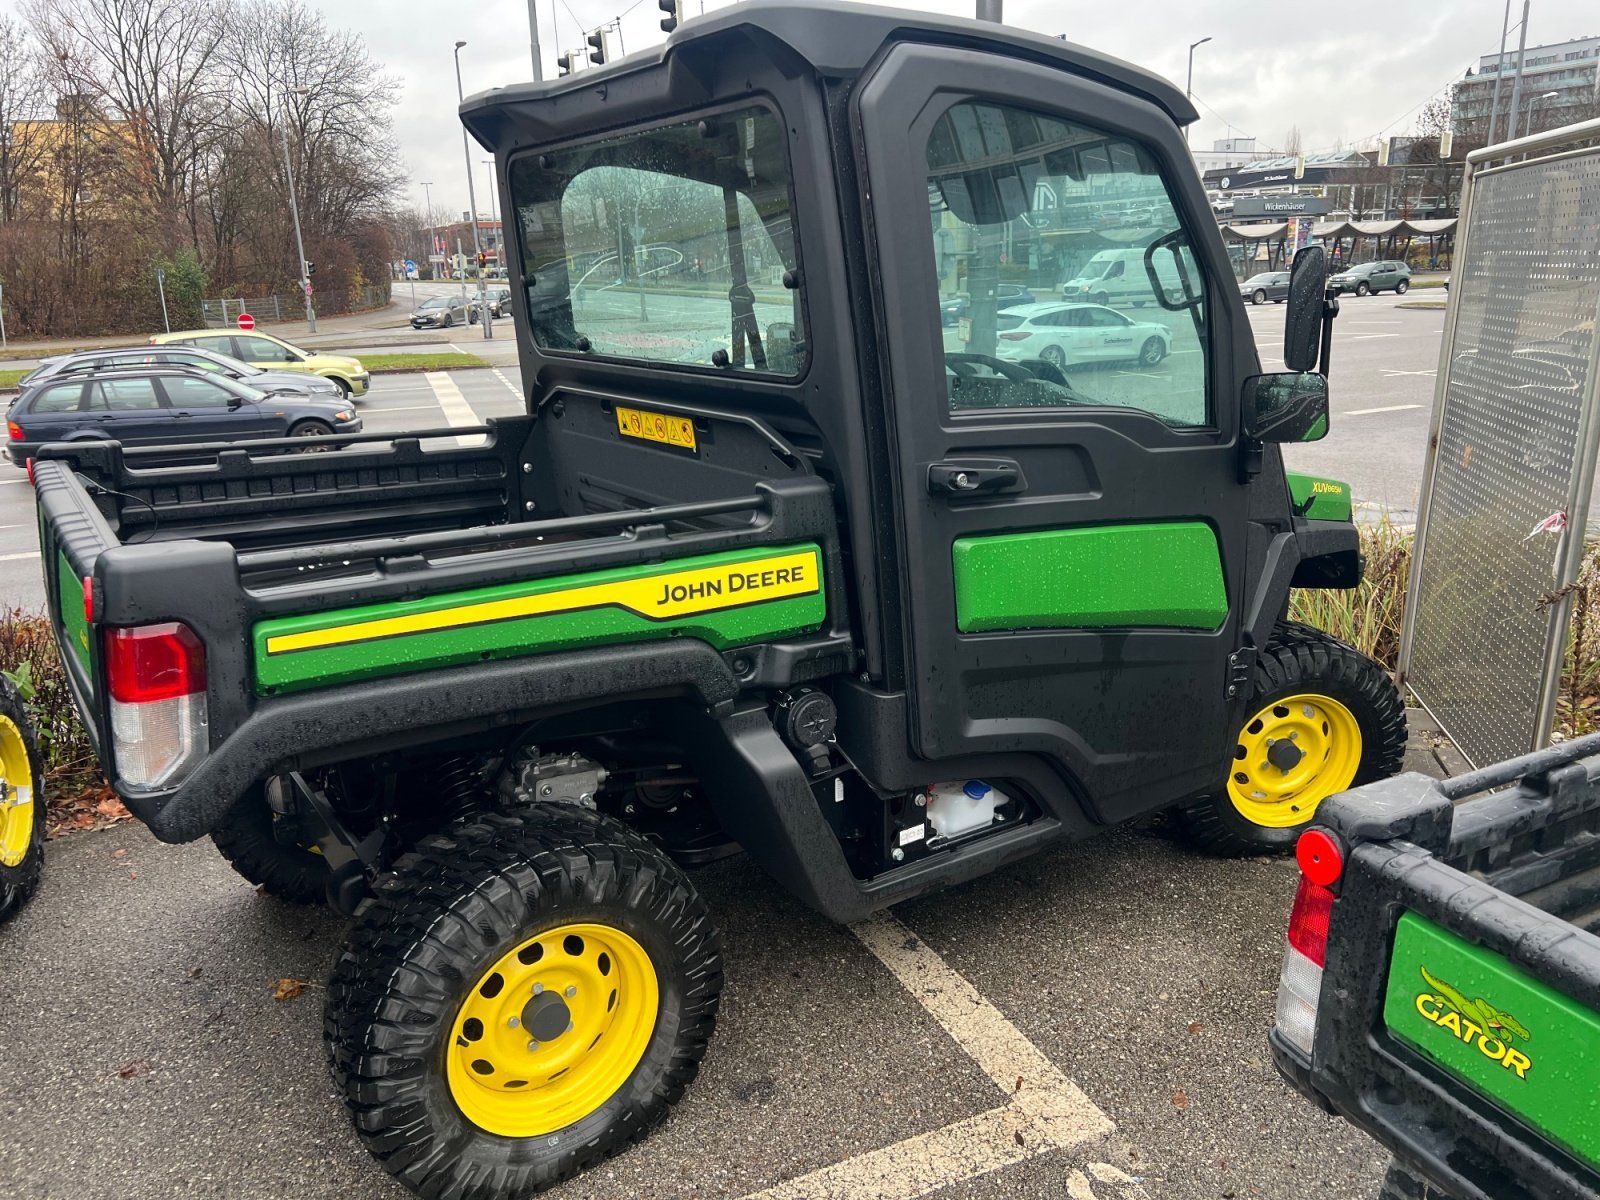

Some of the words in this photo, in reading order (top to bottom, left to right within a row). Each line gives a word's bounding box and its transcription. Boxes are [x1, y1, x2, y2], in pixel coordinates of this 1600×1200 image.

[1264, 202, 1305, 211] Wickenhäuser
[656, 579, 722, 605] JOHN
[728, 566, 804, 593] DEERE
[1416, 993, 1531, 1078] GATOR
